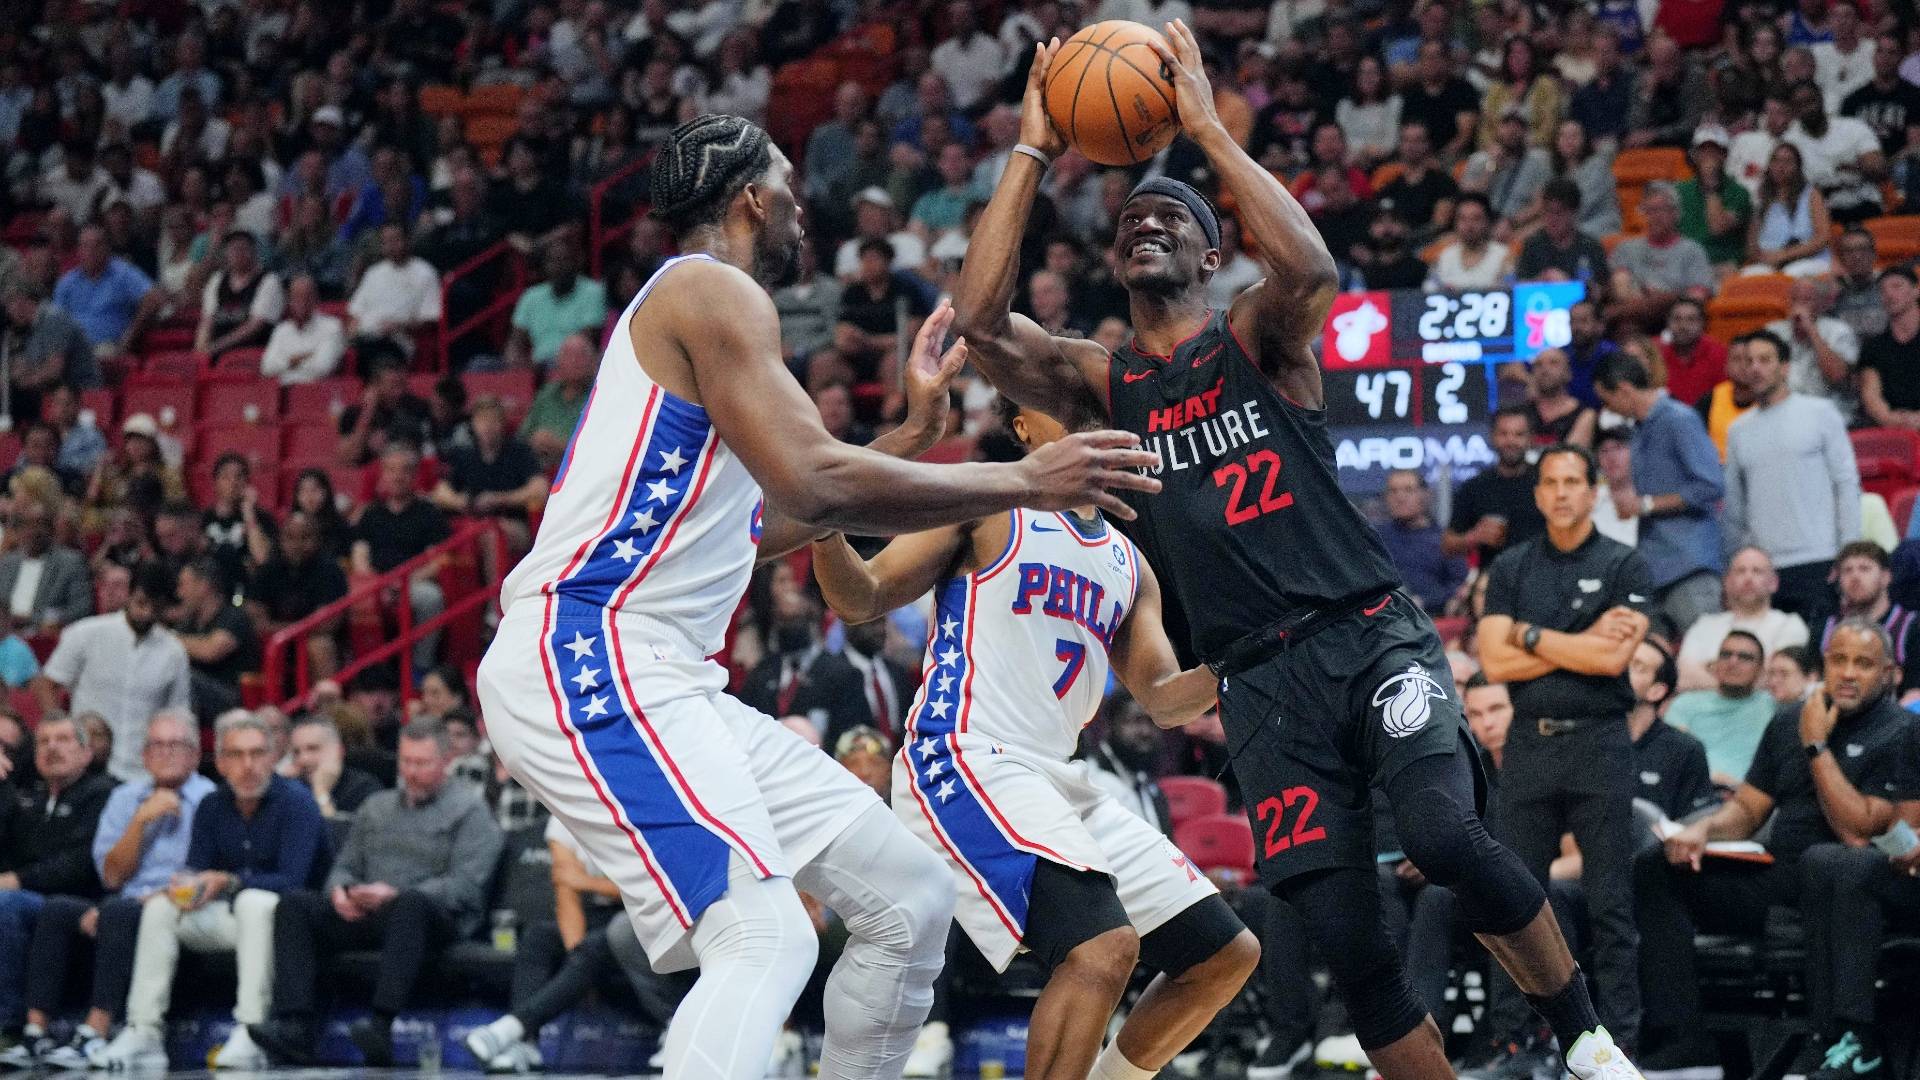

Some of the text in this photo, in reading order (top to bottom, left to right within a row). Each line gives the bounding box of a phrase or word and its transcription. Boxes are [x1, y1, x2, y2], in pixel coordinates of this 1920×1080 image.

[1418, 291, 1510, 341] 2:28
[1147, 376, 1225, 433] HEAT
[1355, 370, 1412, 420] 47
[1335, 434, 1499, 471] AROMA
[1212, 448, 1294, 528] 22
[1052, 638, 1086, 701] 7
[1256, 785, 1327, 860] 22
